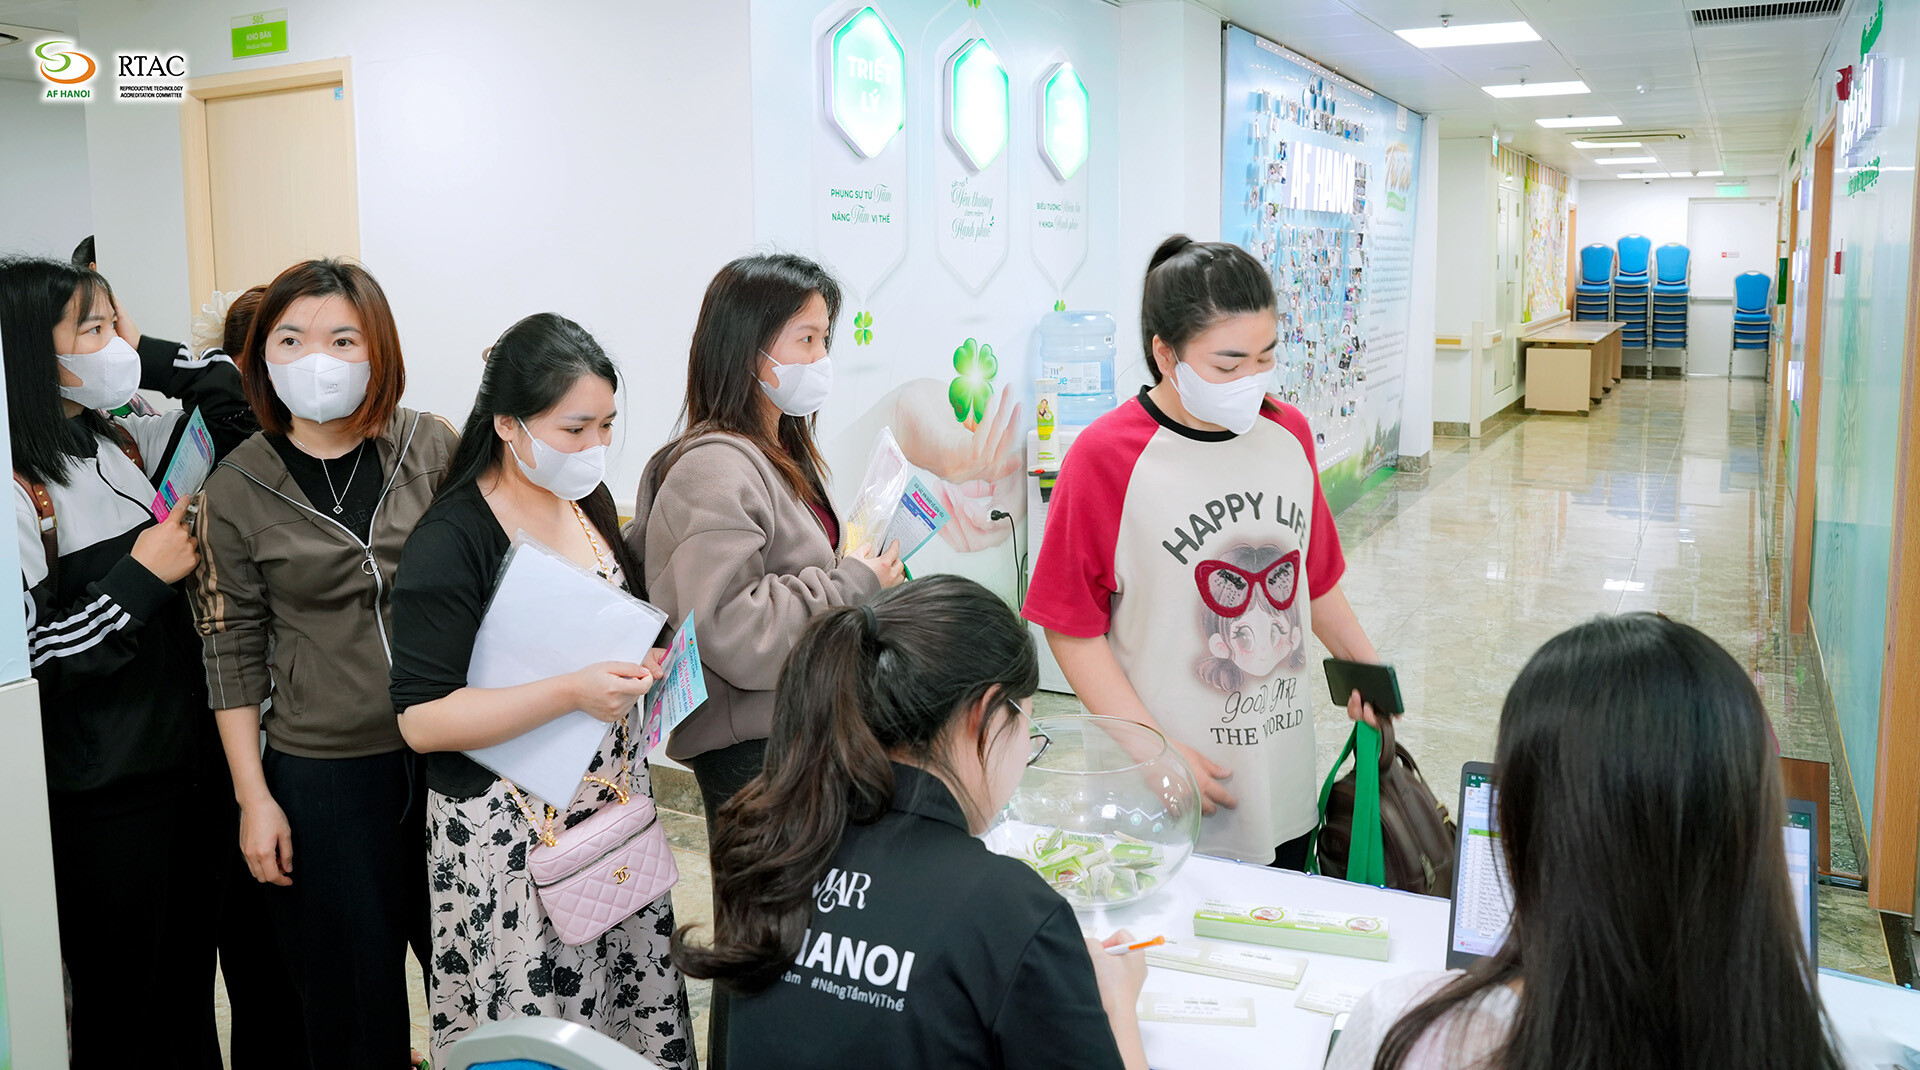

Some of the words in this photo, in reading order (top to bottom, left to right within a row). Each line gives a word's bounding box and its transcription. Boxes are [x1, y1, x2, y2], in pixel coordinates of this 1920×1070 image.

[1290, 141, 1312, 210] AF
[1313, 146, 1356, 215] HANOI
[1162, 491, 1264, 565] HAPPY
[1210, 727, 1259, 746] THE
